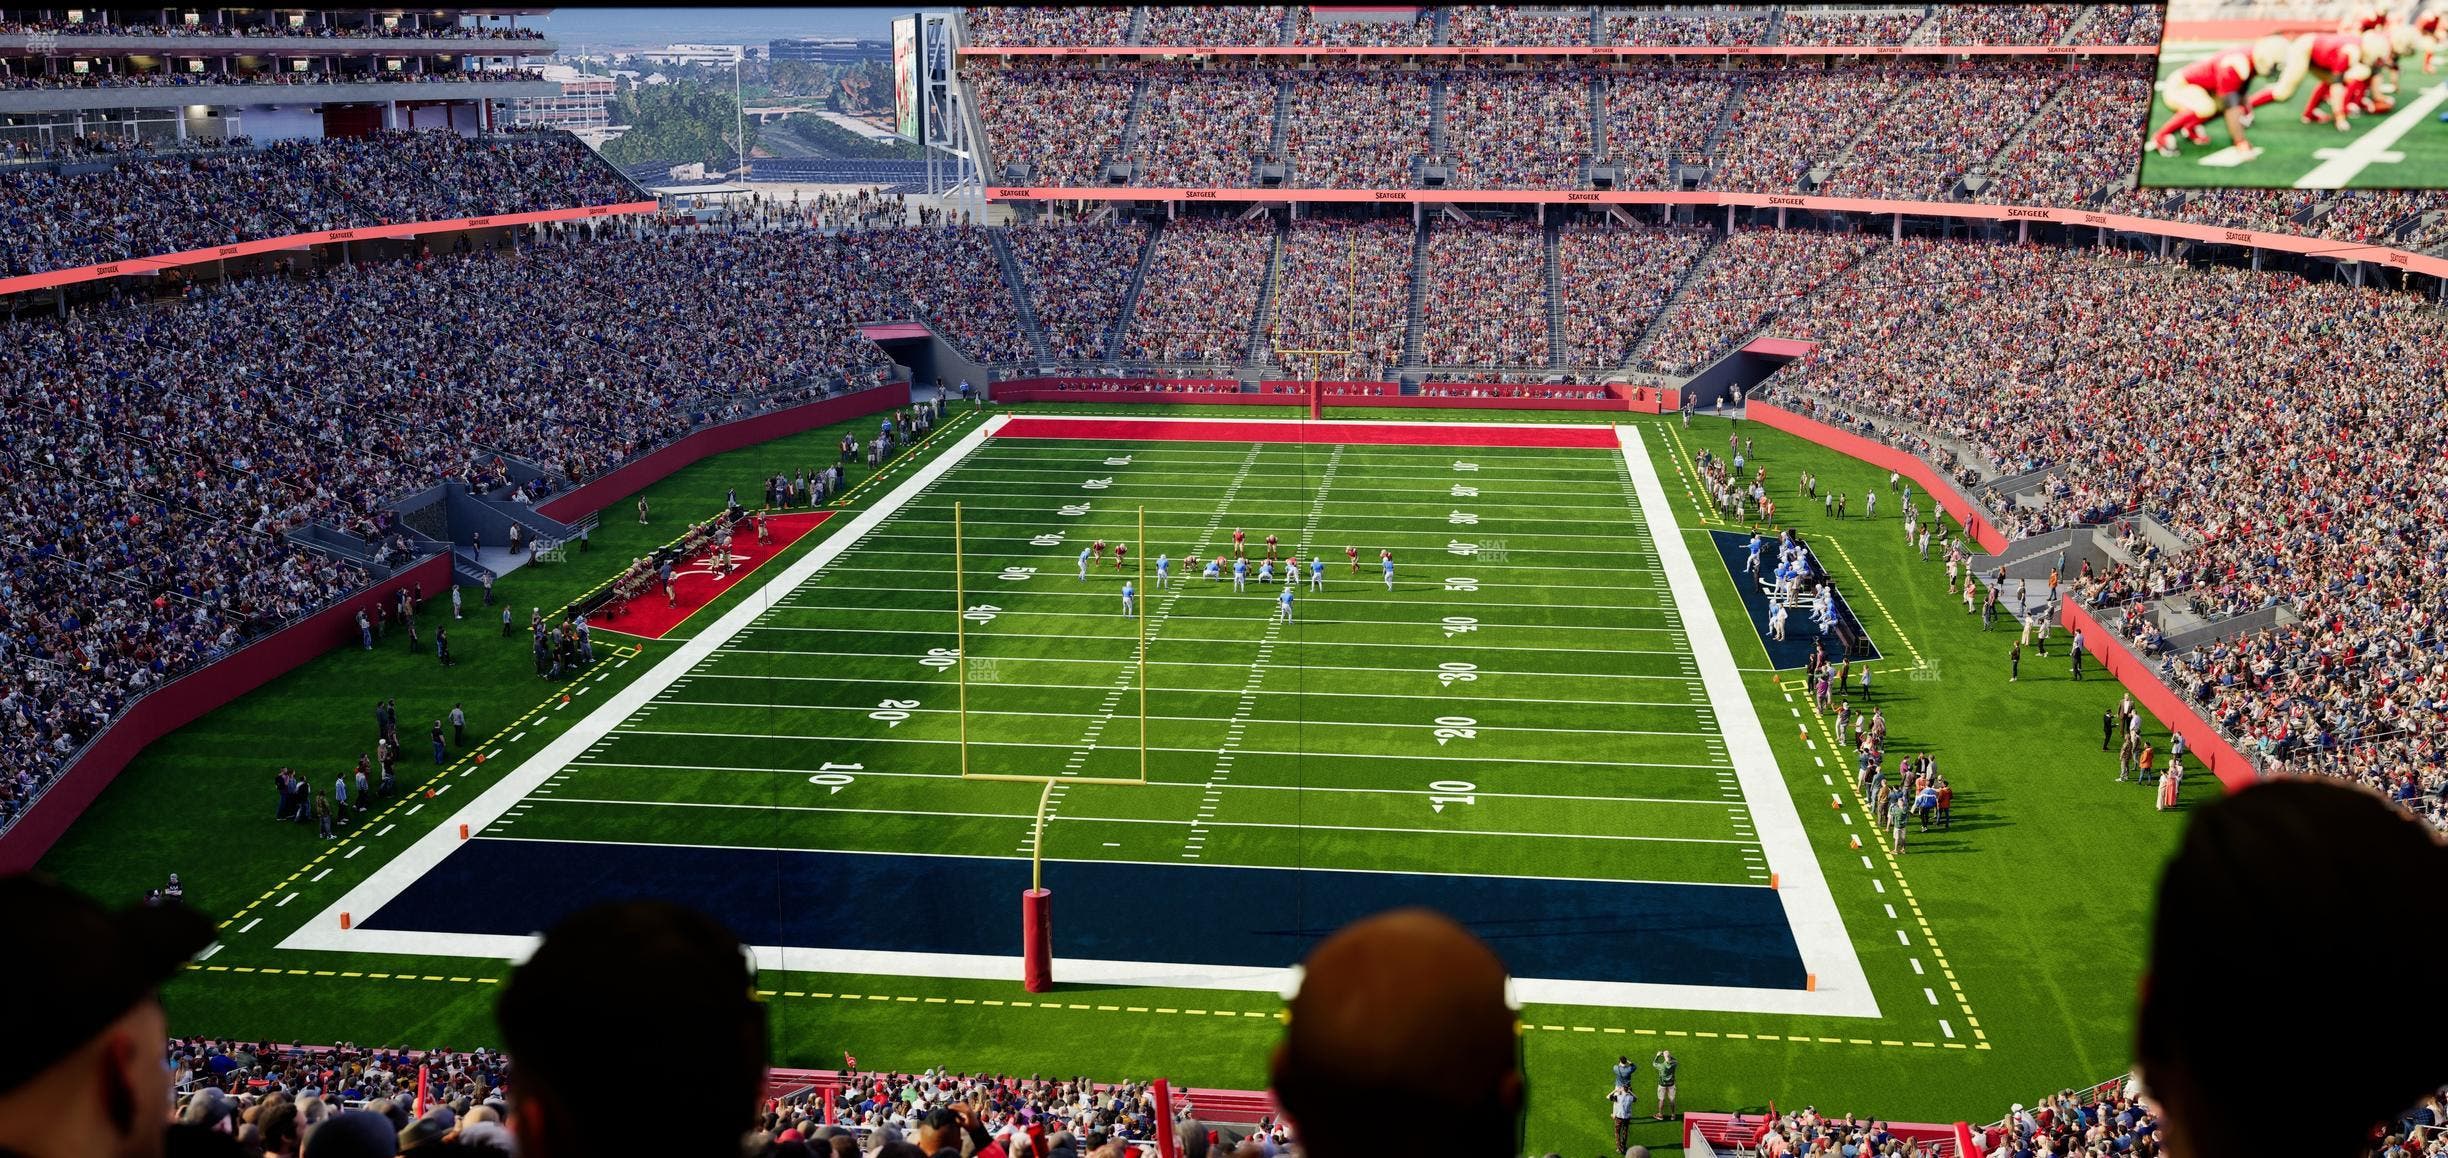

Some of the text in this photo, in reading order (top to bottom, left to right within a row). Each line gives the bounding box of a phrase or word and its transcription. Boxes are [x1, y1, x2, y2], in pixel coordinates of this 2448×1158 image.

[1000, 189, 1030, 197] SEATGEEK
[1186, 190, 1216, 198] SEATGEEK
[1375, 192, 1406, 200] SEATGEEK
[1568, 193, 1600, 201] SEATGEEK
[1768, 196, 1804, 206] SEATGEEK
[2008, 208, 2050, 219] SEATGEEK
[2085, 214, 2107, 225] SEATGEEK
[2225, 231, 2252, 243] SEATGEEK
[997, 566, 1038, 580] 50
[1444, 577, 1479, 592] 50
[963, 604, 1002, 620] 40
[1441, 616, 1479, 632] 40
[918, 648, 965, 666] 30
[1437, 662, 1478, 682] 30
[868, 699, 921, 720] 20
[1433, 716, 1478, 739] 20
[808, 762, 864, 785] 10
[1428, 780, 1477, 805] 10
